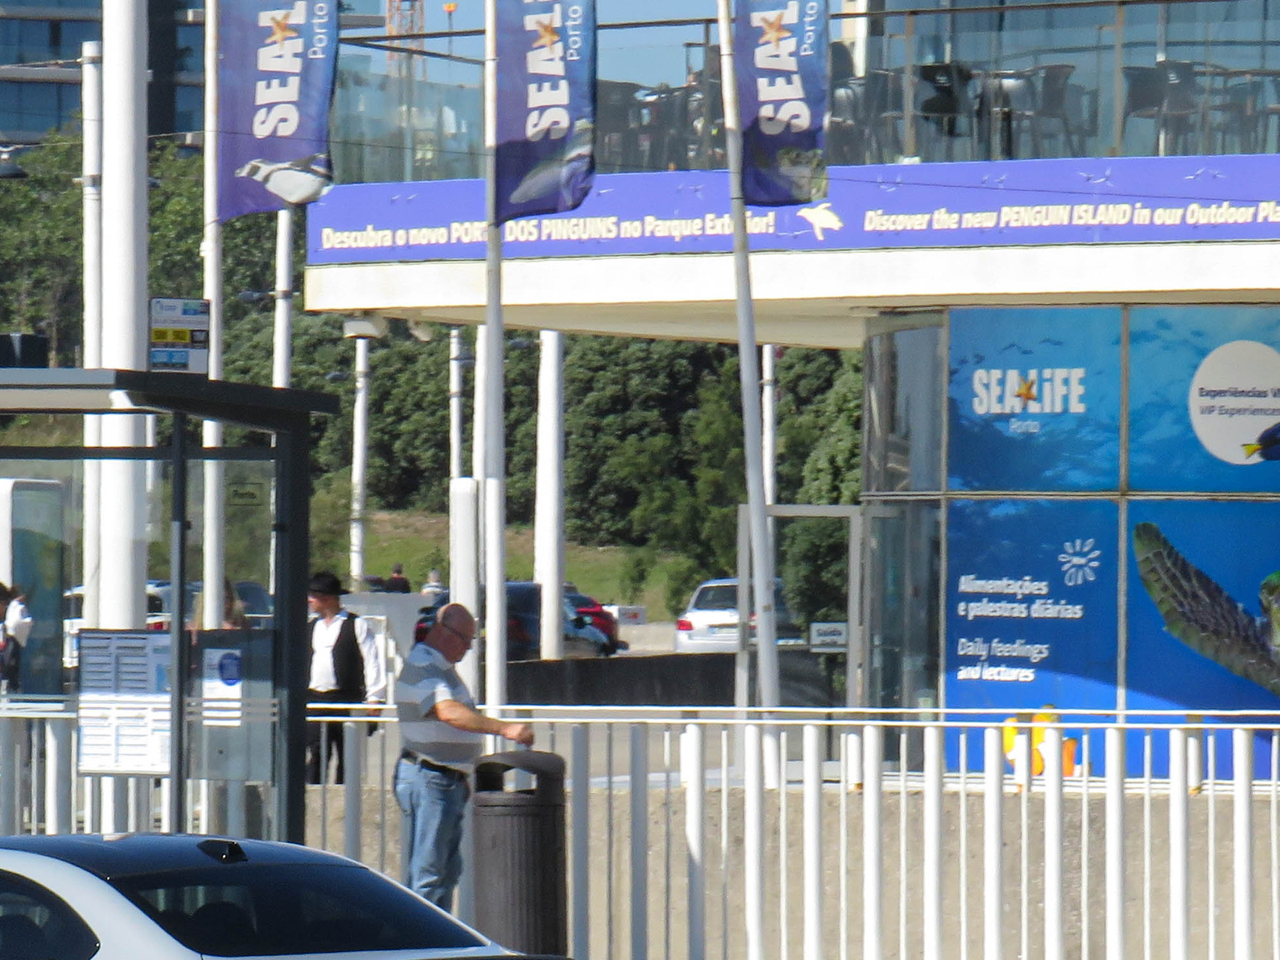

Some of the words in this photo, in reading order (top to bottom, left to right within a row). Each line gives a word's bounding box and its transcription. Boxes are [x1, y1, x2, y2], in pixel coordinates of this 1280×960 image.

[307, 3, 329, 59] Porto
[565, 5, 583, 61] Porto
[800, 1, 819, 56] Porto
[523, 0, 571, 142] SEAL
[322, 224, 393, 249] Descubra
[395, 229, 407, 246] o
[408, 226, 449, 245] novo
[450, 220, 489, 243] PORT
[505, 218, 539, 242] DOS
[540, 216, 619, 241] PINGUINS
[620, 219, 642, 239] no
[644, 215, 703, 241] Parque
[864, 209, 931, 231] Discover
[932, 207, 960, 230] the
[961, 212, 998, 229] new
[999, 204, 1071, 228] PENGUIN
[1072, 203, 1133, 226] ISLAND
[1133, 202, 1152, 225] in
[1153, 207, 1185, 225] our
[1186, 201, 1257, 225] Outdoor
[958, 574, 1049, 599] Alimentações
[957, 602, 968, 616] e
[967, 597, 1028, 620] palestras
[1029, 599, 1083, 618] diárias
[957, 638, 990, 661] Daily
[990, 638, 1050, 663] feedings
[957, 662, 982, 680] and
[982, 662, 1036, 682] lectures
